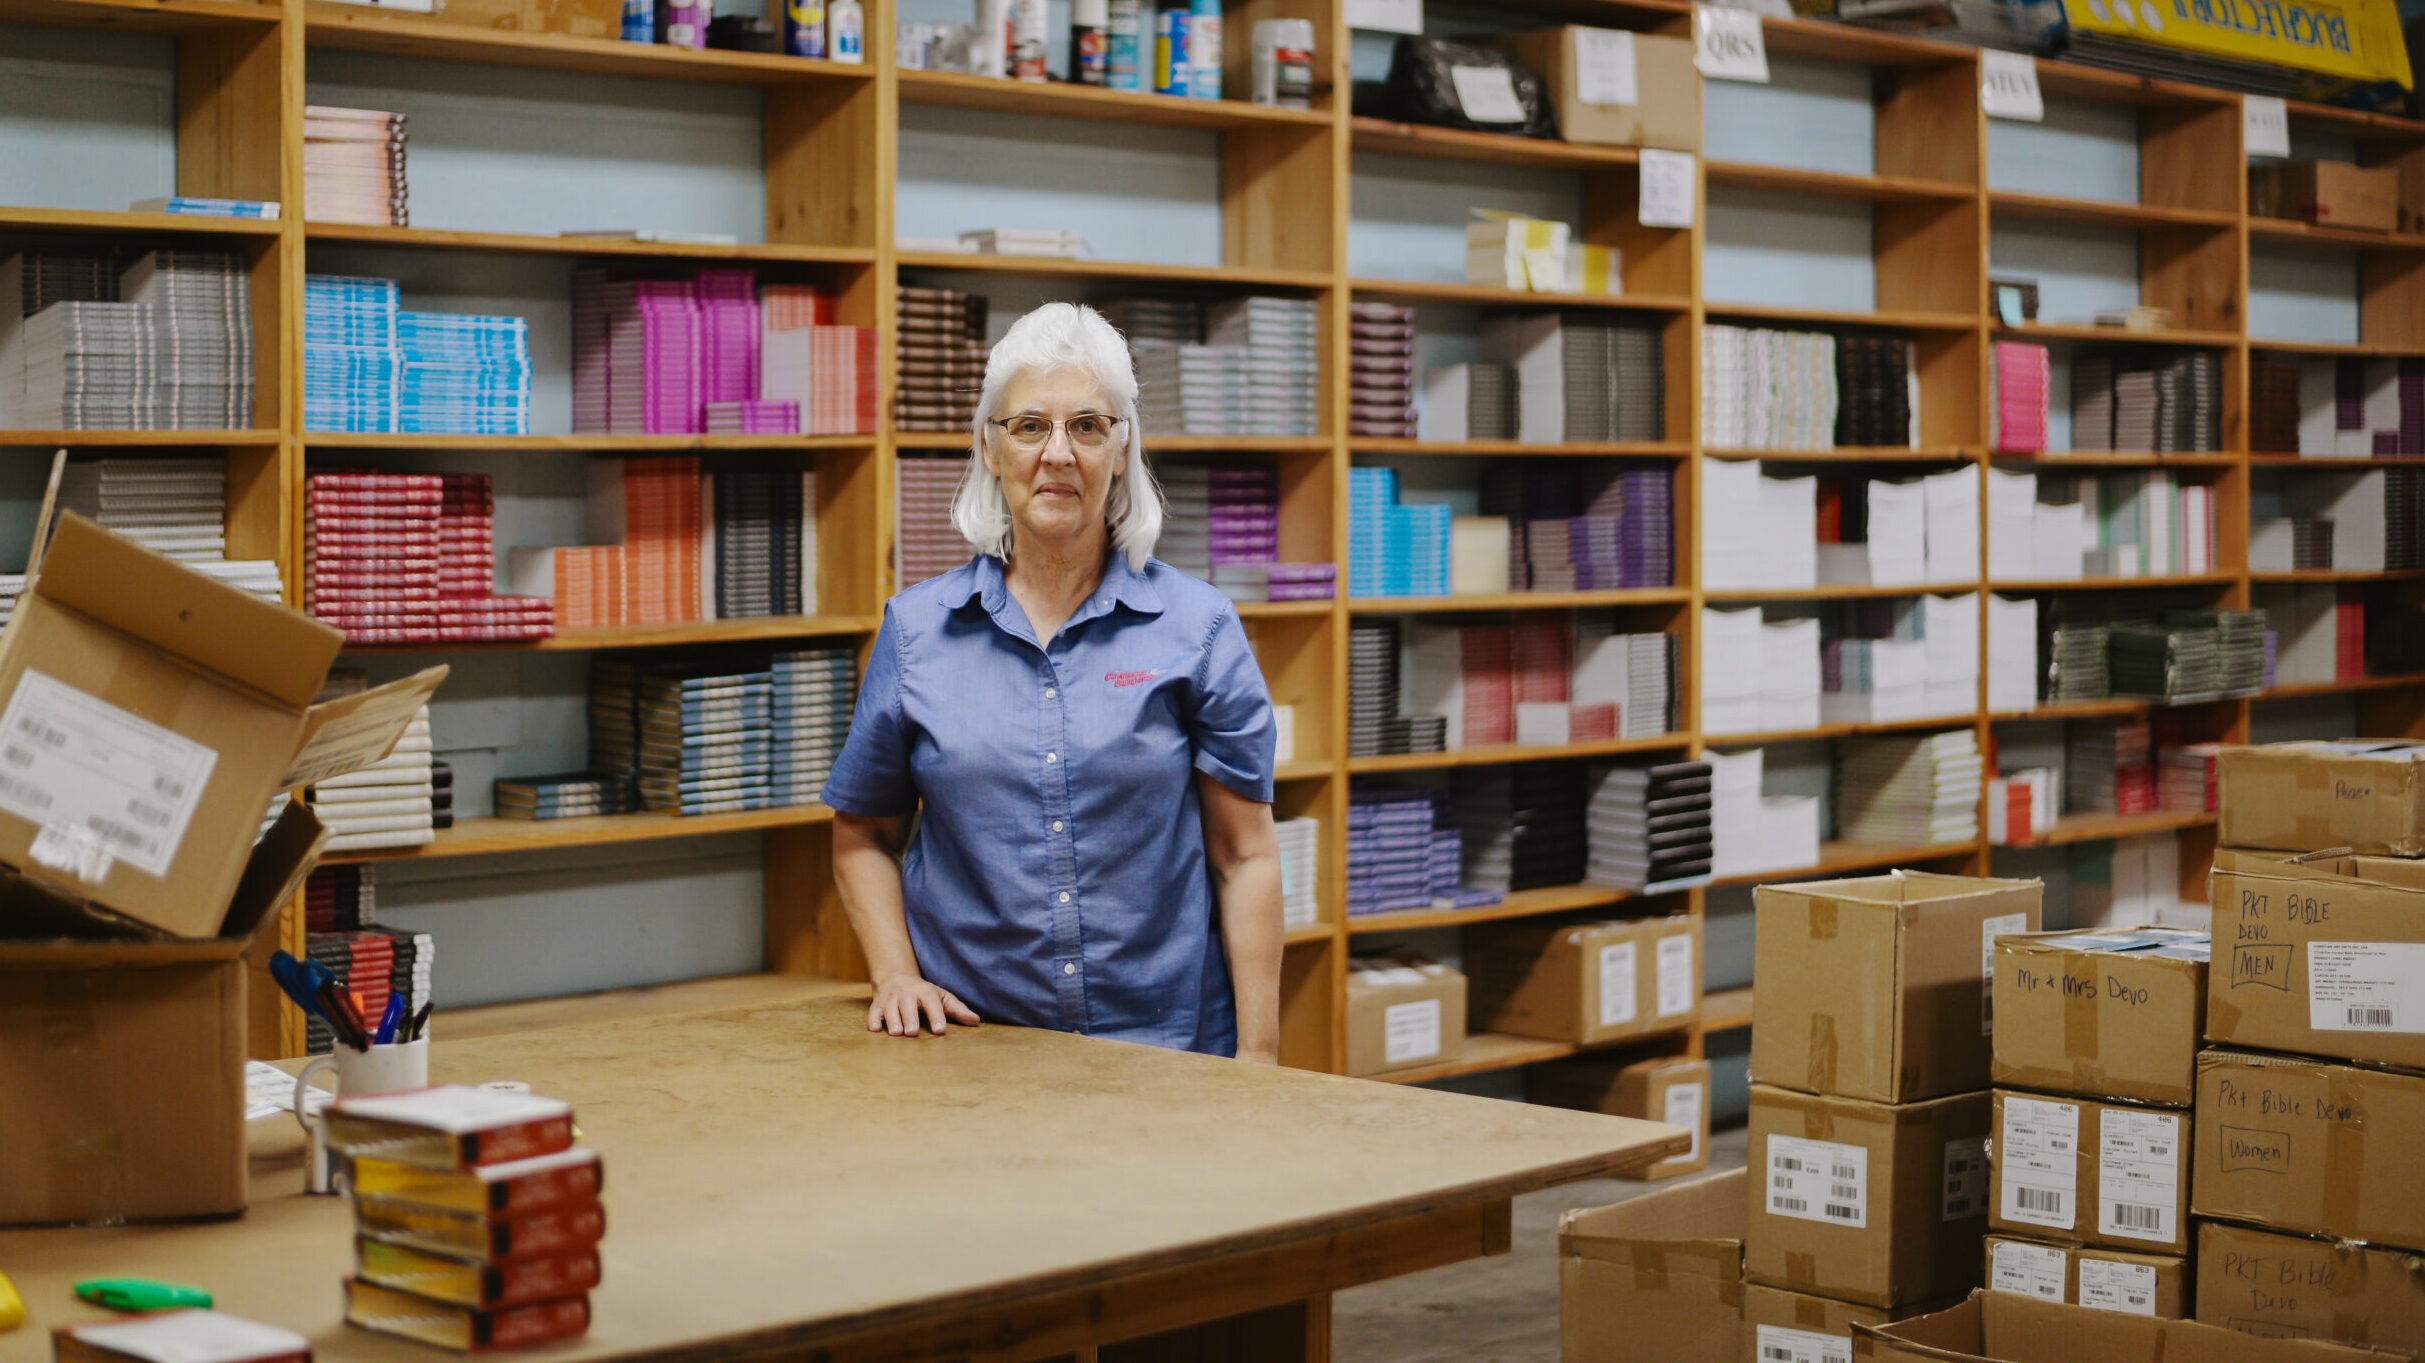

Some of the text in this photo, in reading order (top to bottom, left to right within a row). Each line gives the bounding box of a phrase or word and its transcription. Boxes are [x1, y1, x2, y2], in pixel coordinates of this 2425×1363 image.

[1706, 30, 1755, 64] QRS
[2242, 889, 2331, 925] PKT BIBLE
[2238, 923, 2269, 941] DEVO
[2239, 950, 2275, 979] MEN
[2017, 968, 2039, 993] Mr
[2108, 975, 2149, 1006] Devo
[2261, 1088, 2304, 1116] Bible
[2316, 1098, 2353, 1122] Devo
[2229, 1138, 2282, 1161] Women
[2225, 1251, 2265, 1281] PKT
